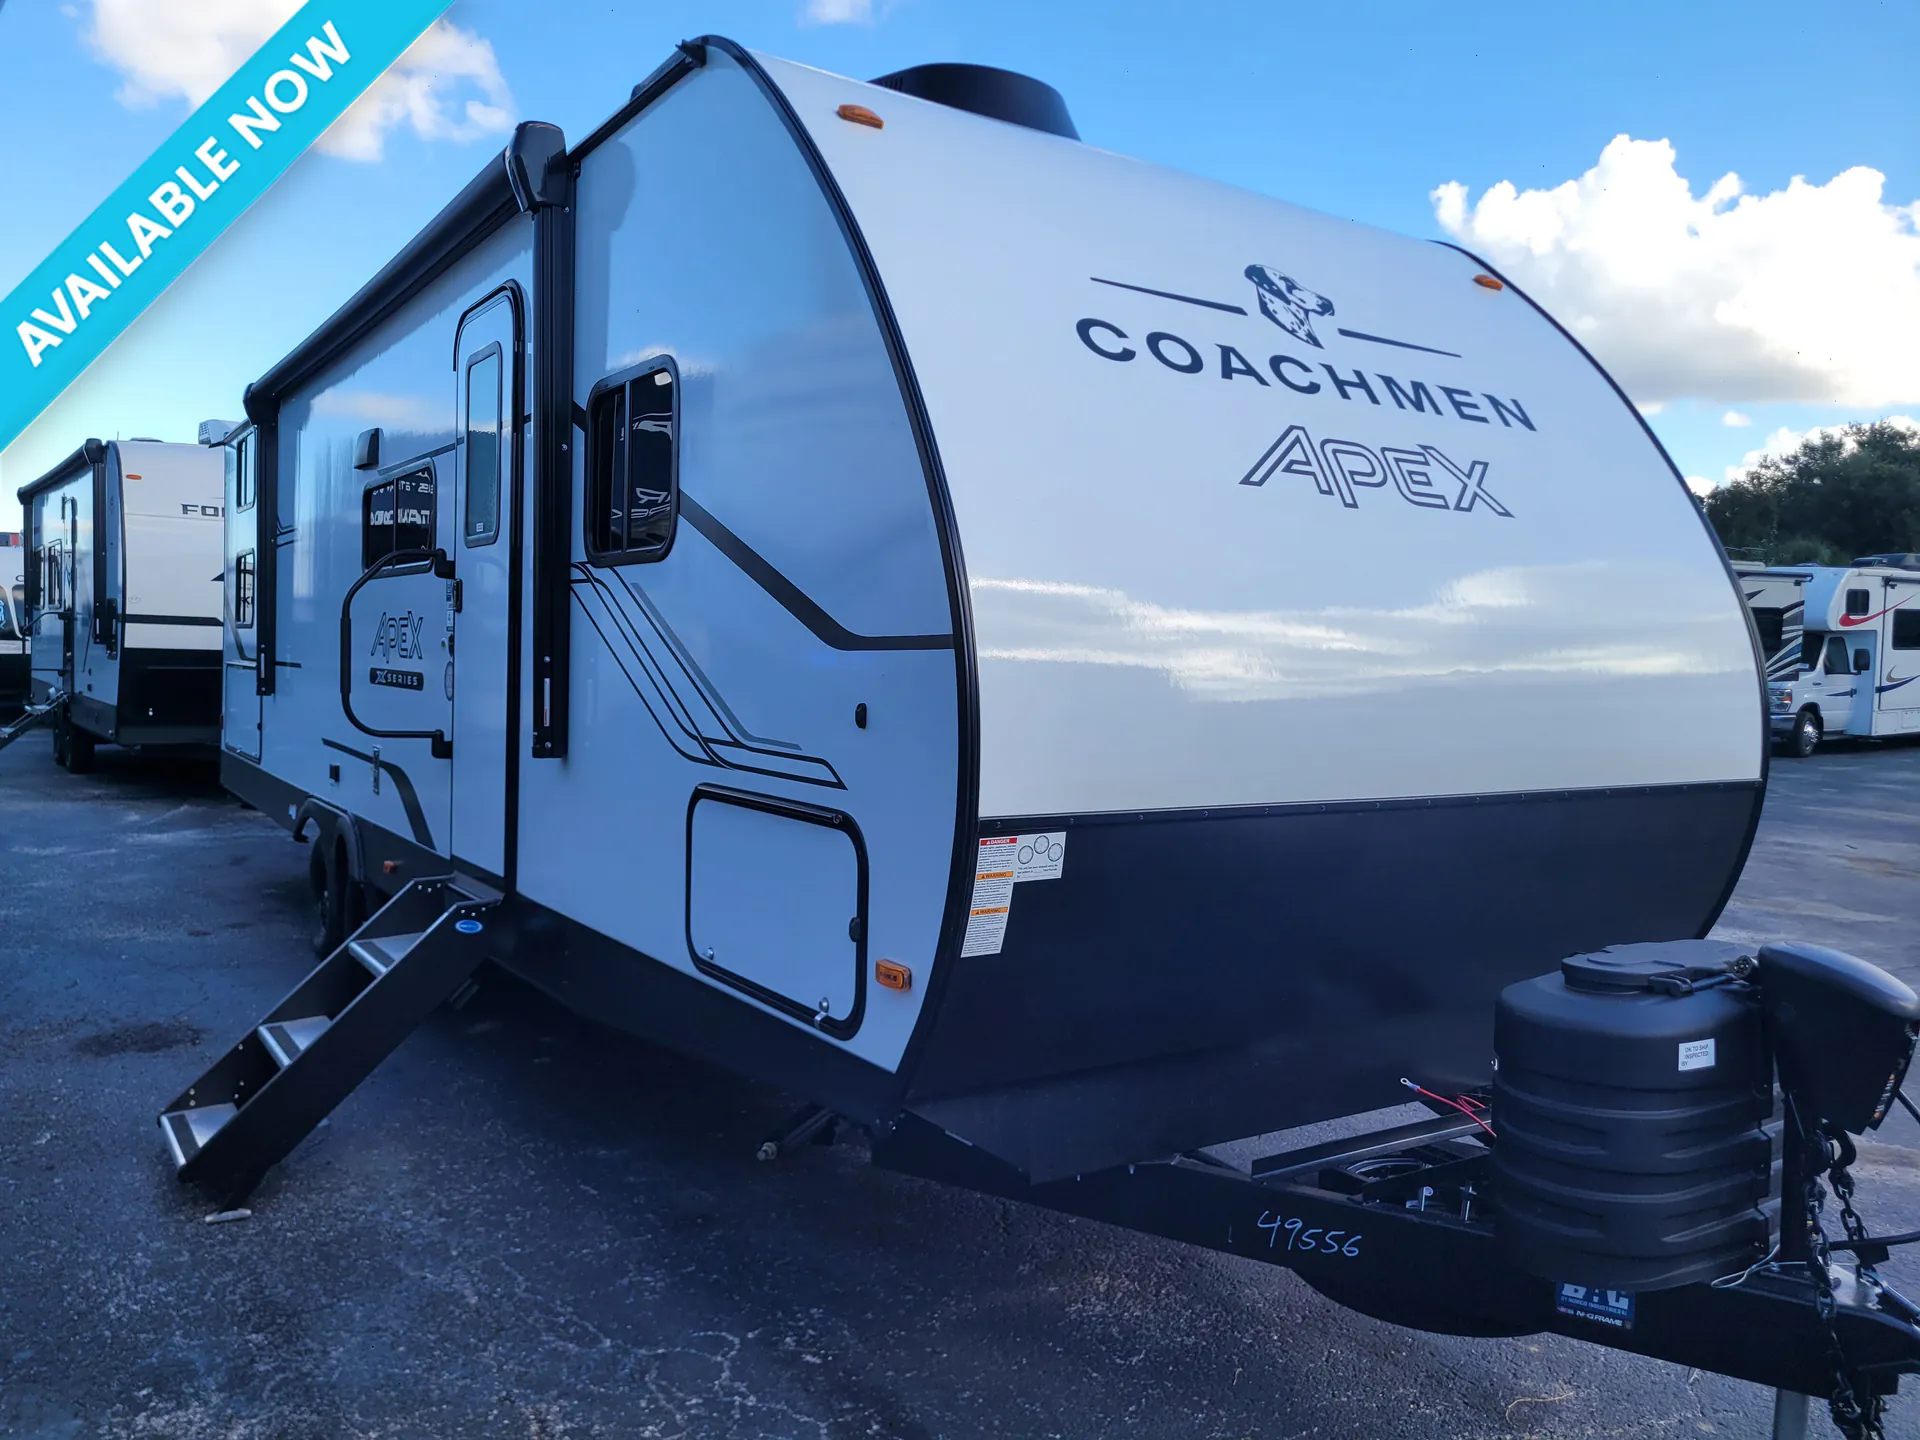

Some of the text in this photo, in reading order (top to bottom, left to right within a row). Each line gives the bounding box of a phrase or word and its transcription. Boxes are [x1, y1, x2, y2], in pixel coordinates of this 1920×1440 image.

[1075, 317, 1538, 432] COACHMEN
[1239, 424, 1515, 518] APEX
[181, 503, 225, 518] FO
[370, 609, 424, 664] APEX
[1684, 1051, 1708, 1059] INSPECTED
[1257, 1210, 1362, 1257] 49556
